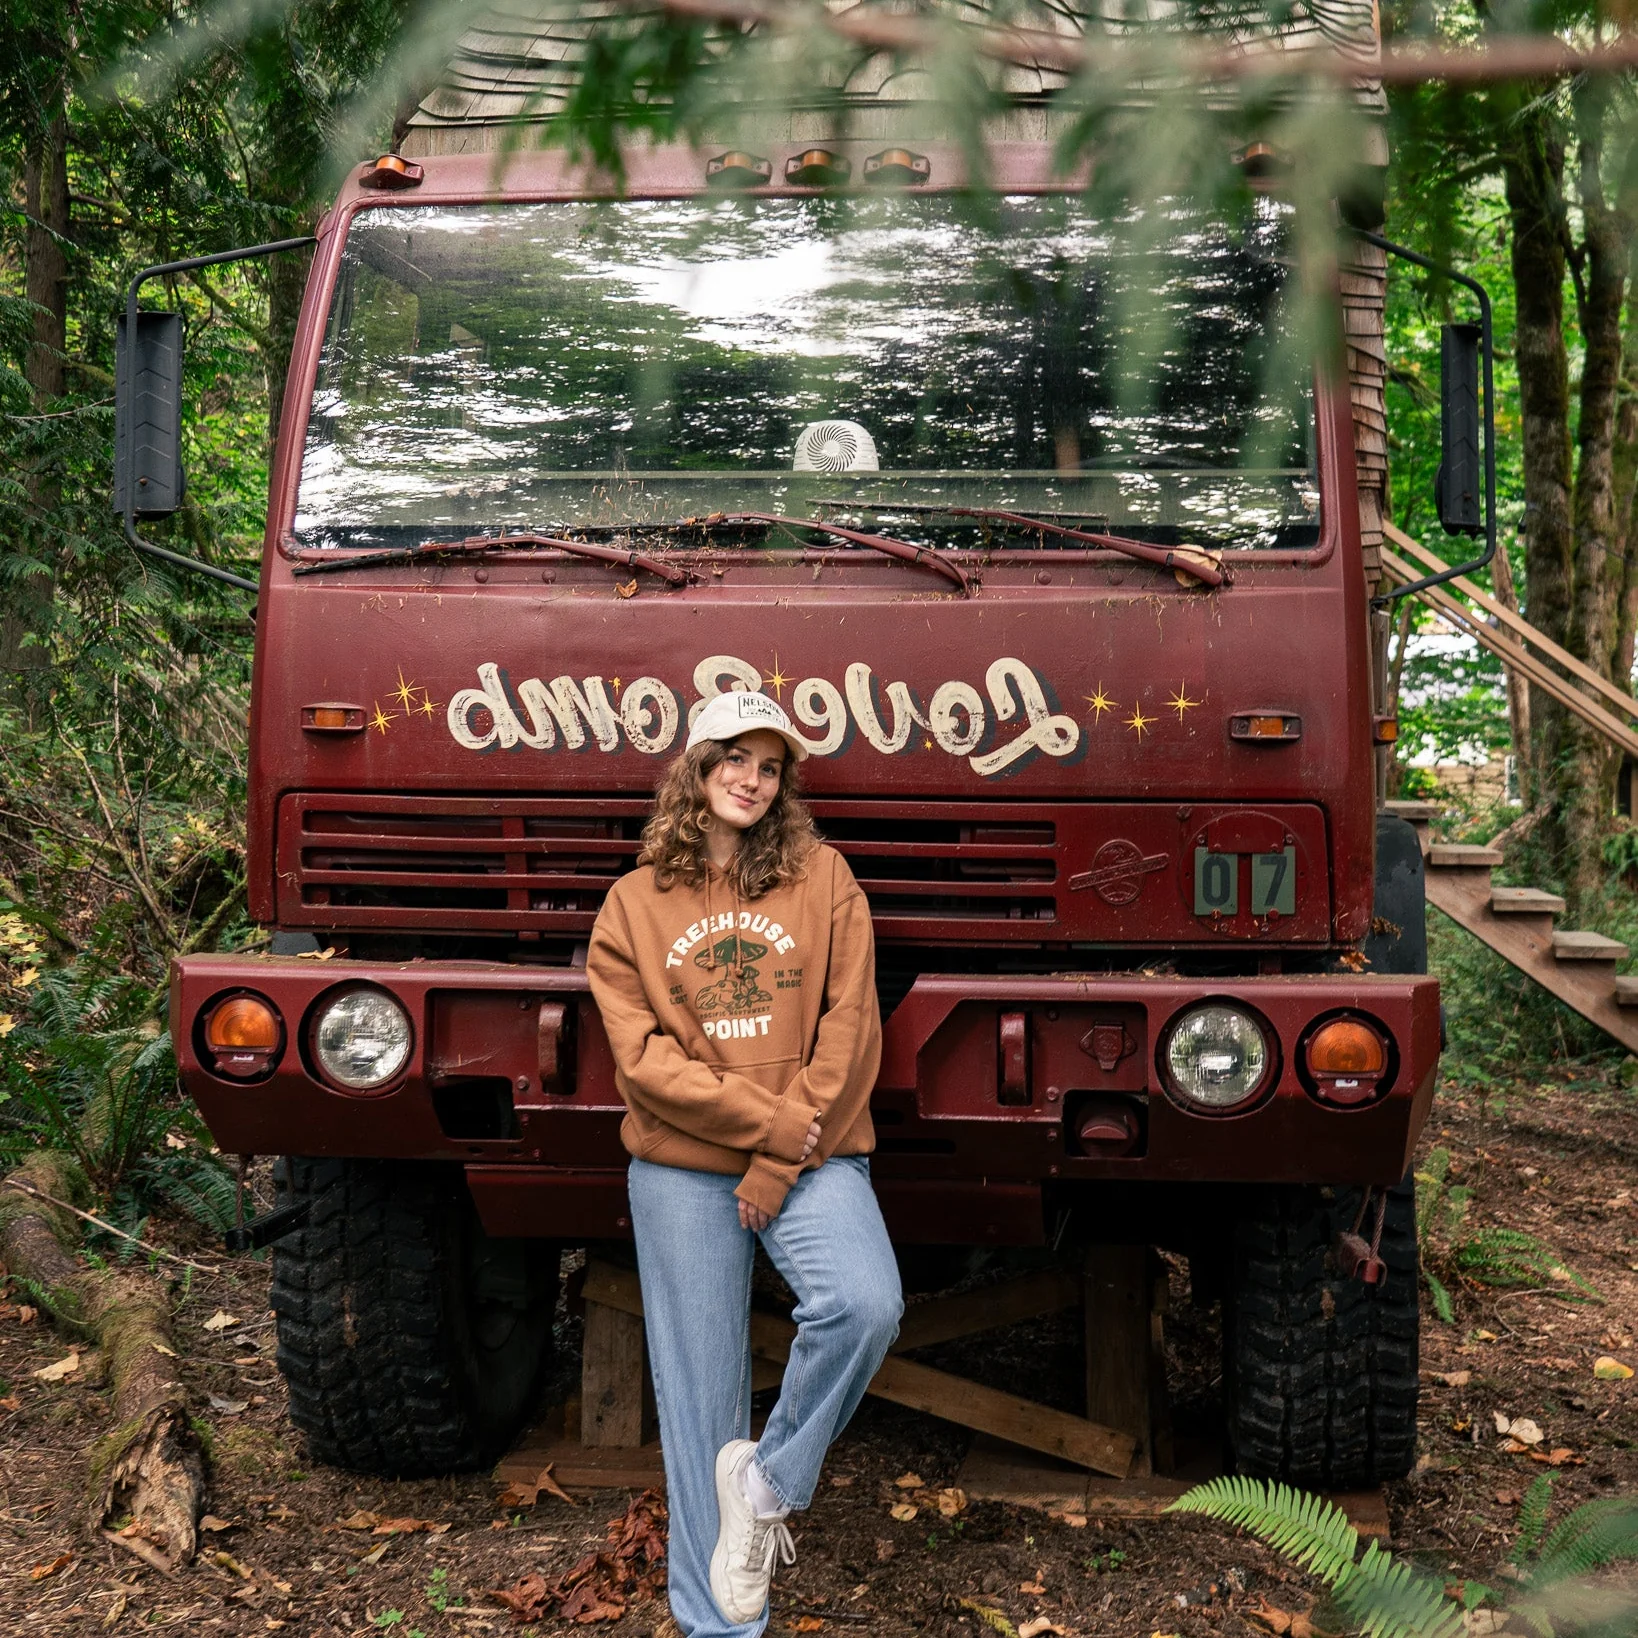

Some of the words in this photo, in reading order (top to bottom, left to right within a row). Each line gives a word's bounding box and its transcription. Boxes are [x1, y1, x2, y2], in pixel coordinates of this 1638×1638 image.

[666, 912, 796, 969] TREEHOUSE
[775, 970, 785, 978] IN
[788, 969, 804, 977] THE
[777, 980, 802, 989] MAGIC
[702, 1016, 772, 1040] POINT
